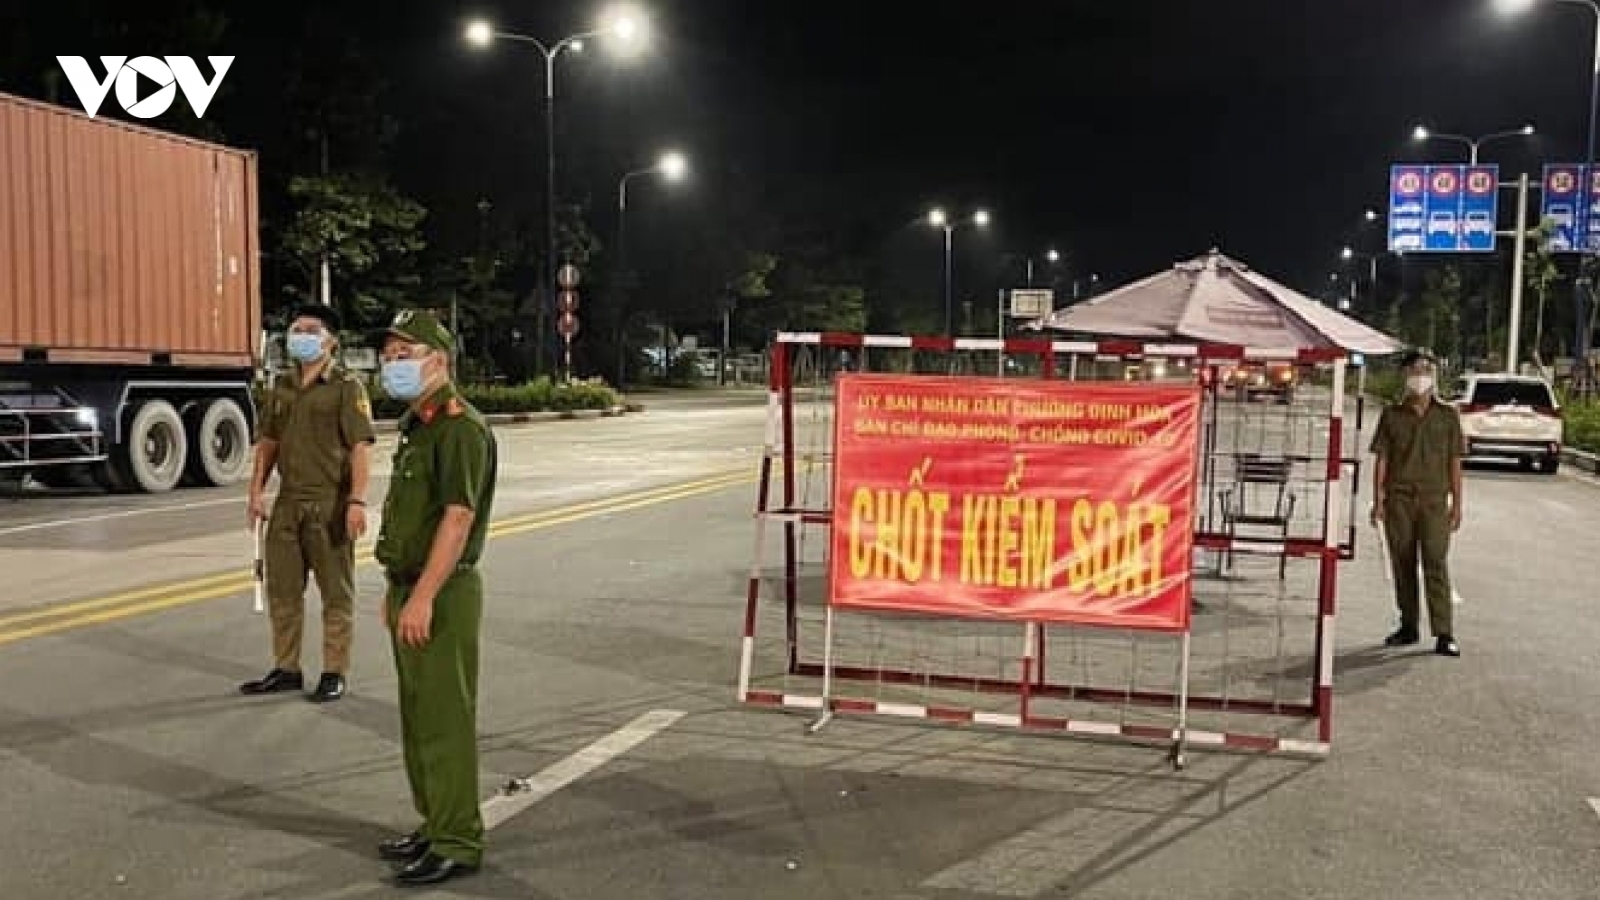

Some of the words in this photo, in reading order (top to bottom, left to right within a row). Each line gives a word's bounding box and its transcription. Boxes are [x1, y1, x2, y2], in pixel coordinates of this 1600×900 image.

[850, 456, 950, 583] CHỐT
[959, 453, 1056, 589] KIỂM
[1068, 478, 1171, 597] SOÁT
